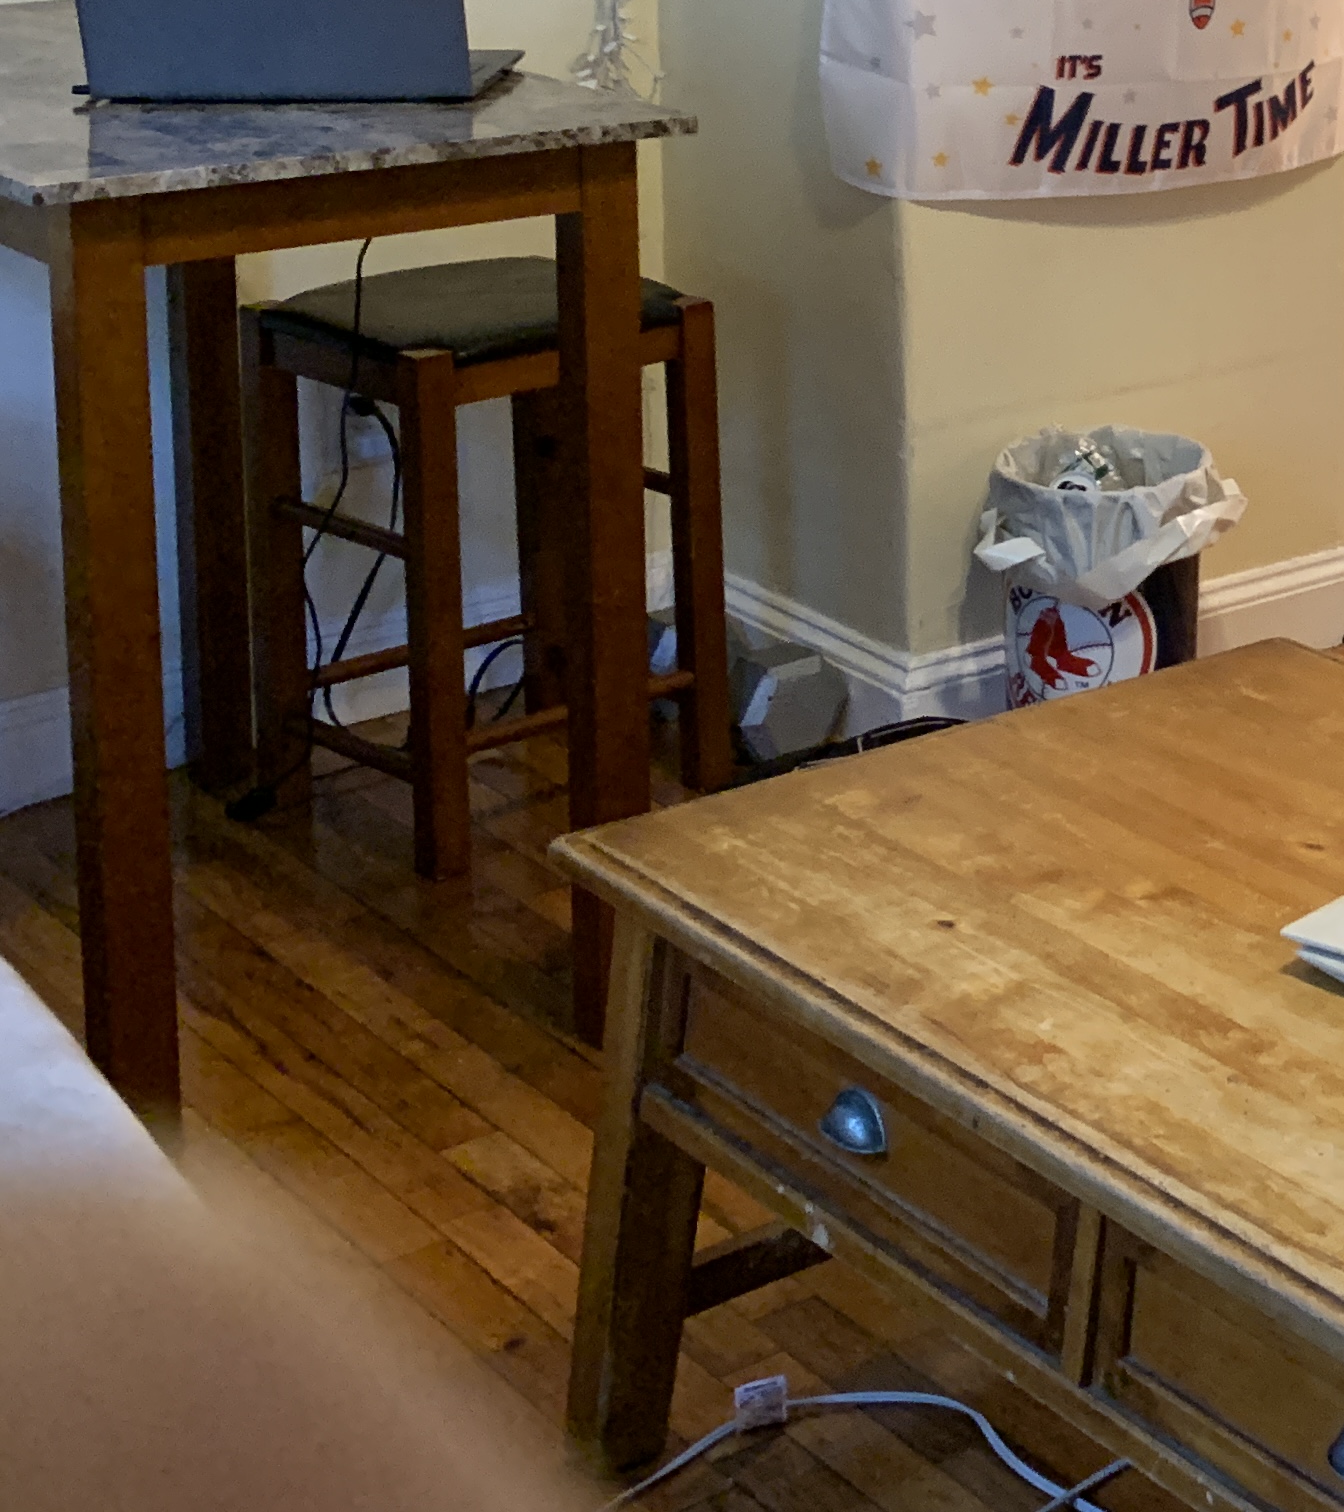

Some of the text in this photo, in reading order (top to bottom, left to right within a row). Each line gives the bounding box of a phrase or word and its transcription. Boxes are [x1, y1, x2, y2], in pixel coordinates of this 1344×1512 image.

[1055, 55, 1103, 80] IT'S
[1007, 60, 1316, 176] MILLER TIME
